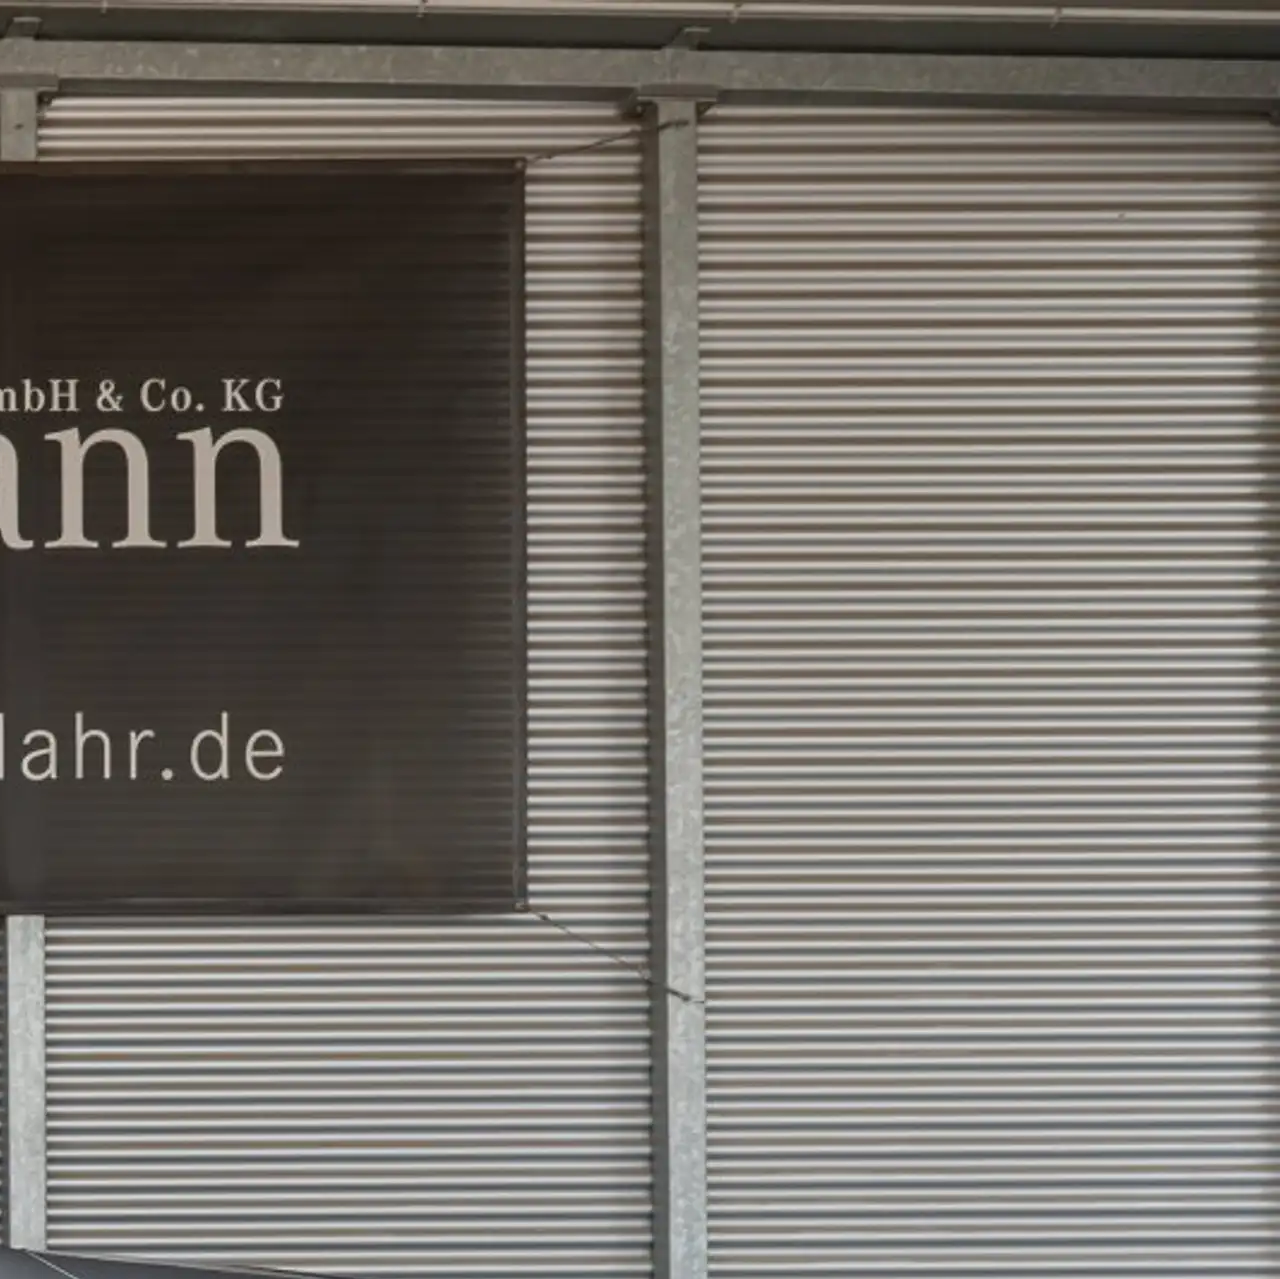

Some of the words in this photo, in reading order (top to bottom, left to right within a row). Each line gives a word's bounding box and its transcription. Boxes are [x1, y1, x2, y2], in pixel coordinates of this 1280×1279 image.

[97, 380, 124, 413] &
[141, 379, 205, 413] Co.
[224, 379, 284, 413] KG
